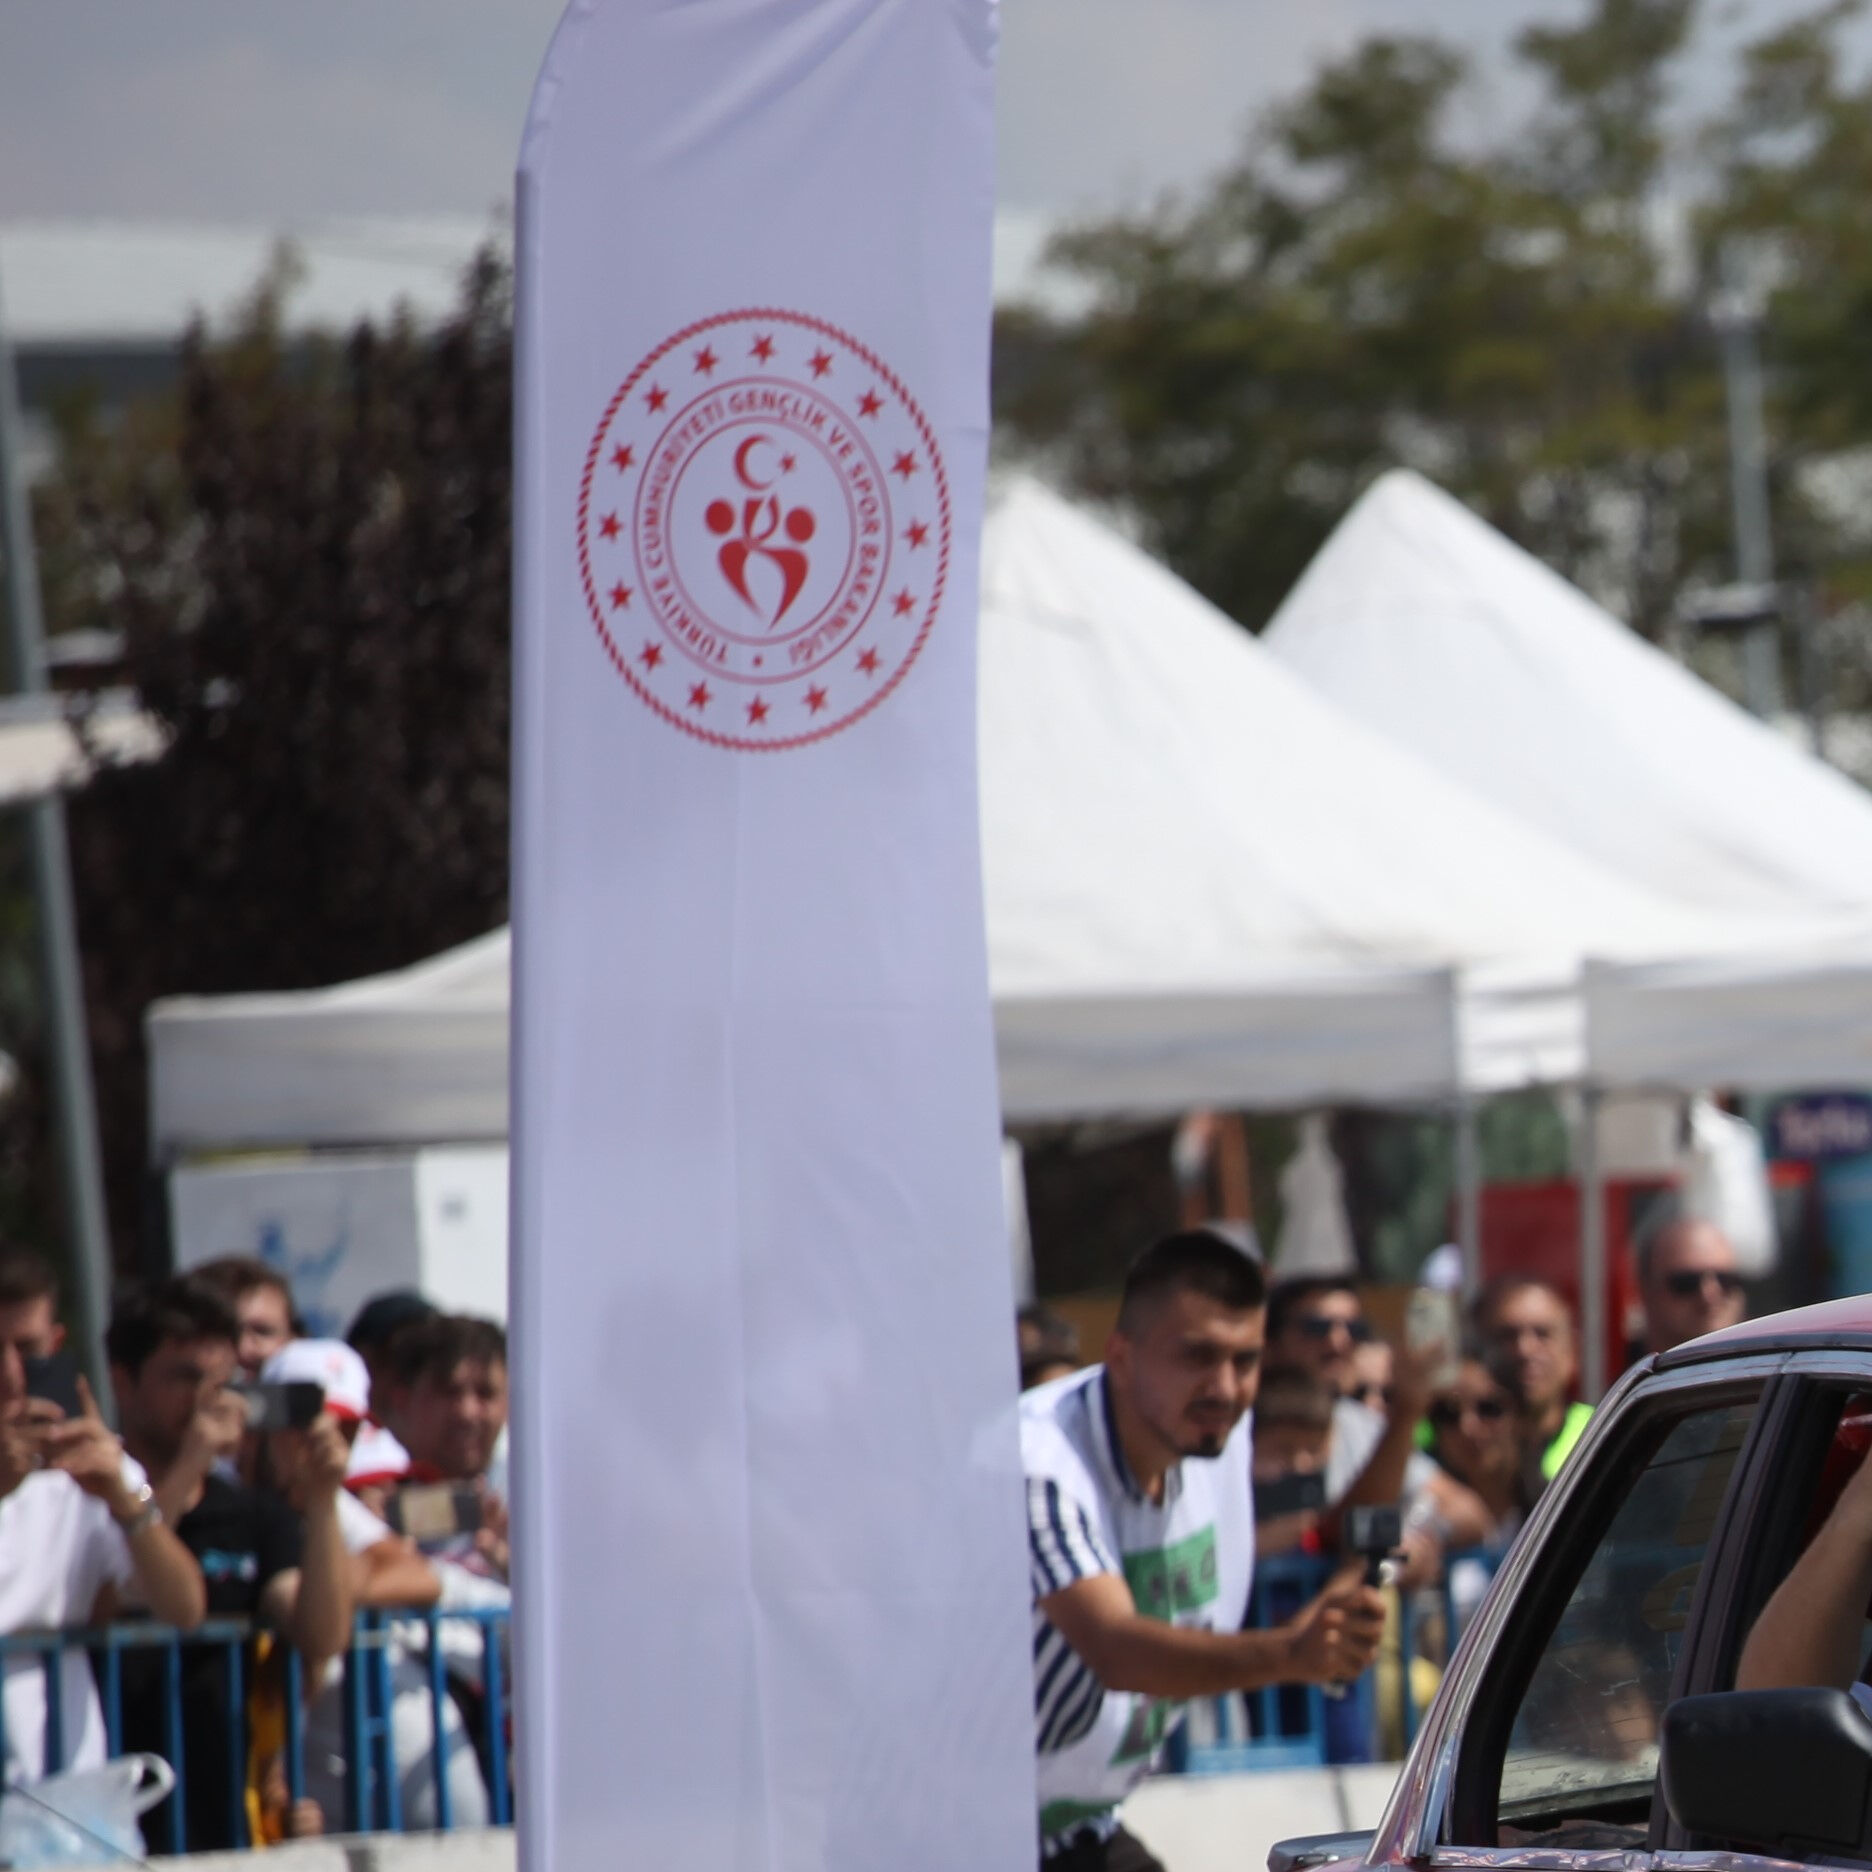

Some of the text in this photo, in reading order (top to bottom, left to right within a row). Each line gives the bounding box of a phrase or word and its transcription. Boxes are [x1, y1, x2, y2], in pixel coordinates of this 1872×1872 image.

[727, 388, 828, 431] GENÇLİK
[827, 424, 855, 460] VE
[849, 461, 881, 536] SPOR
